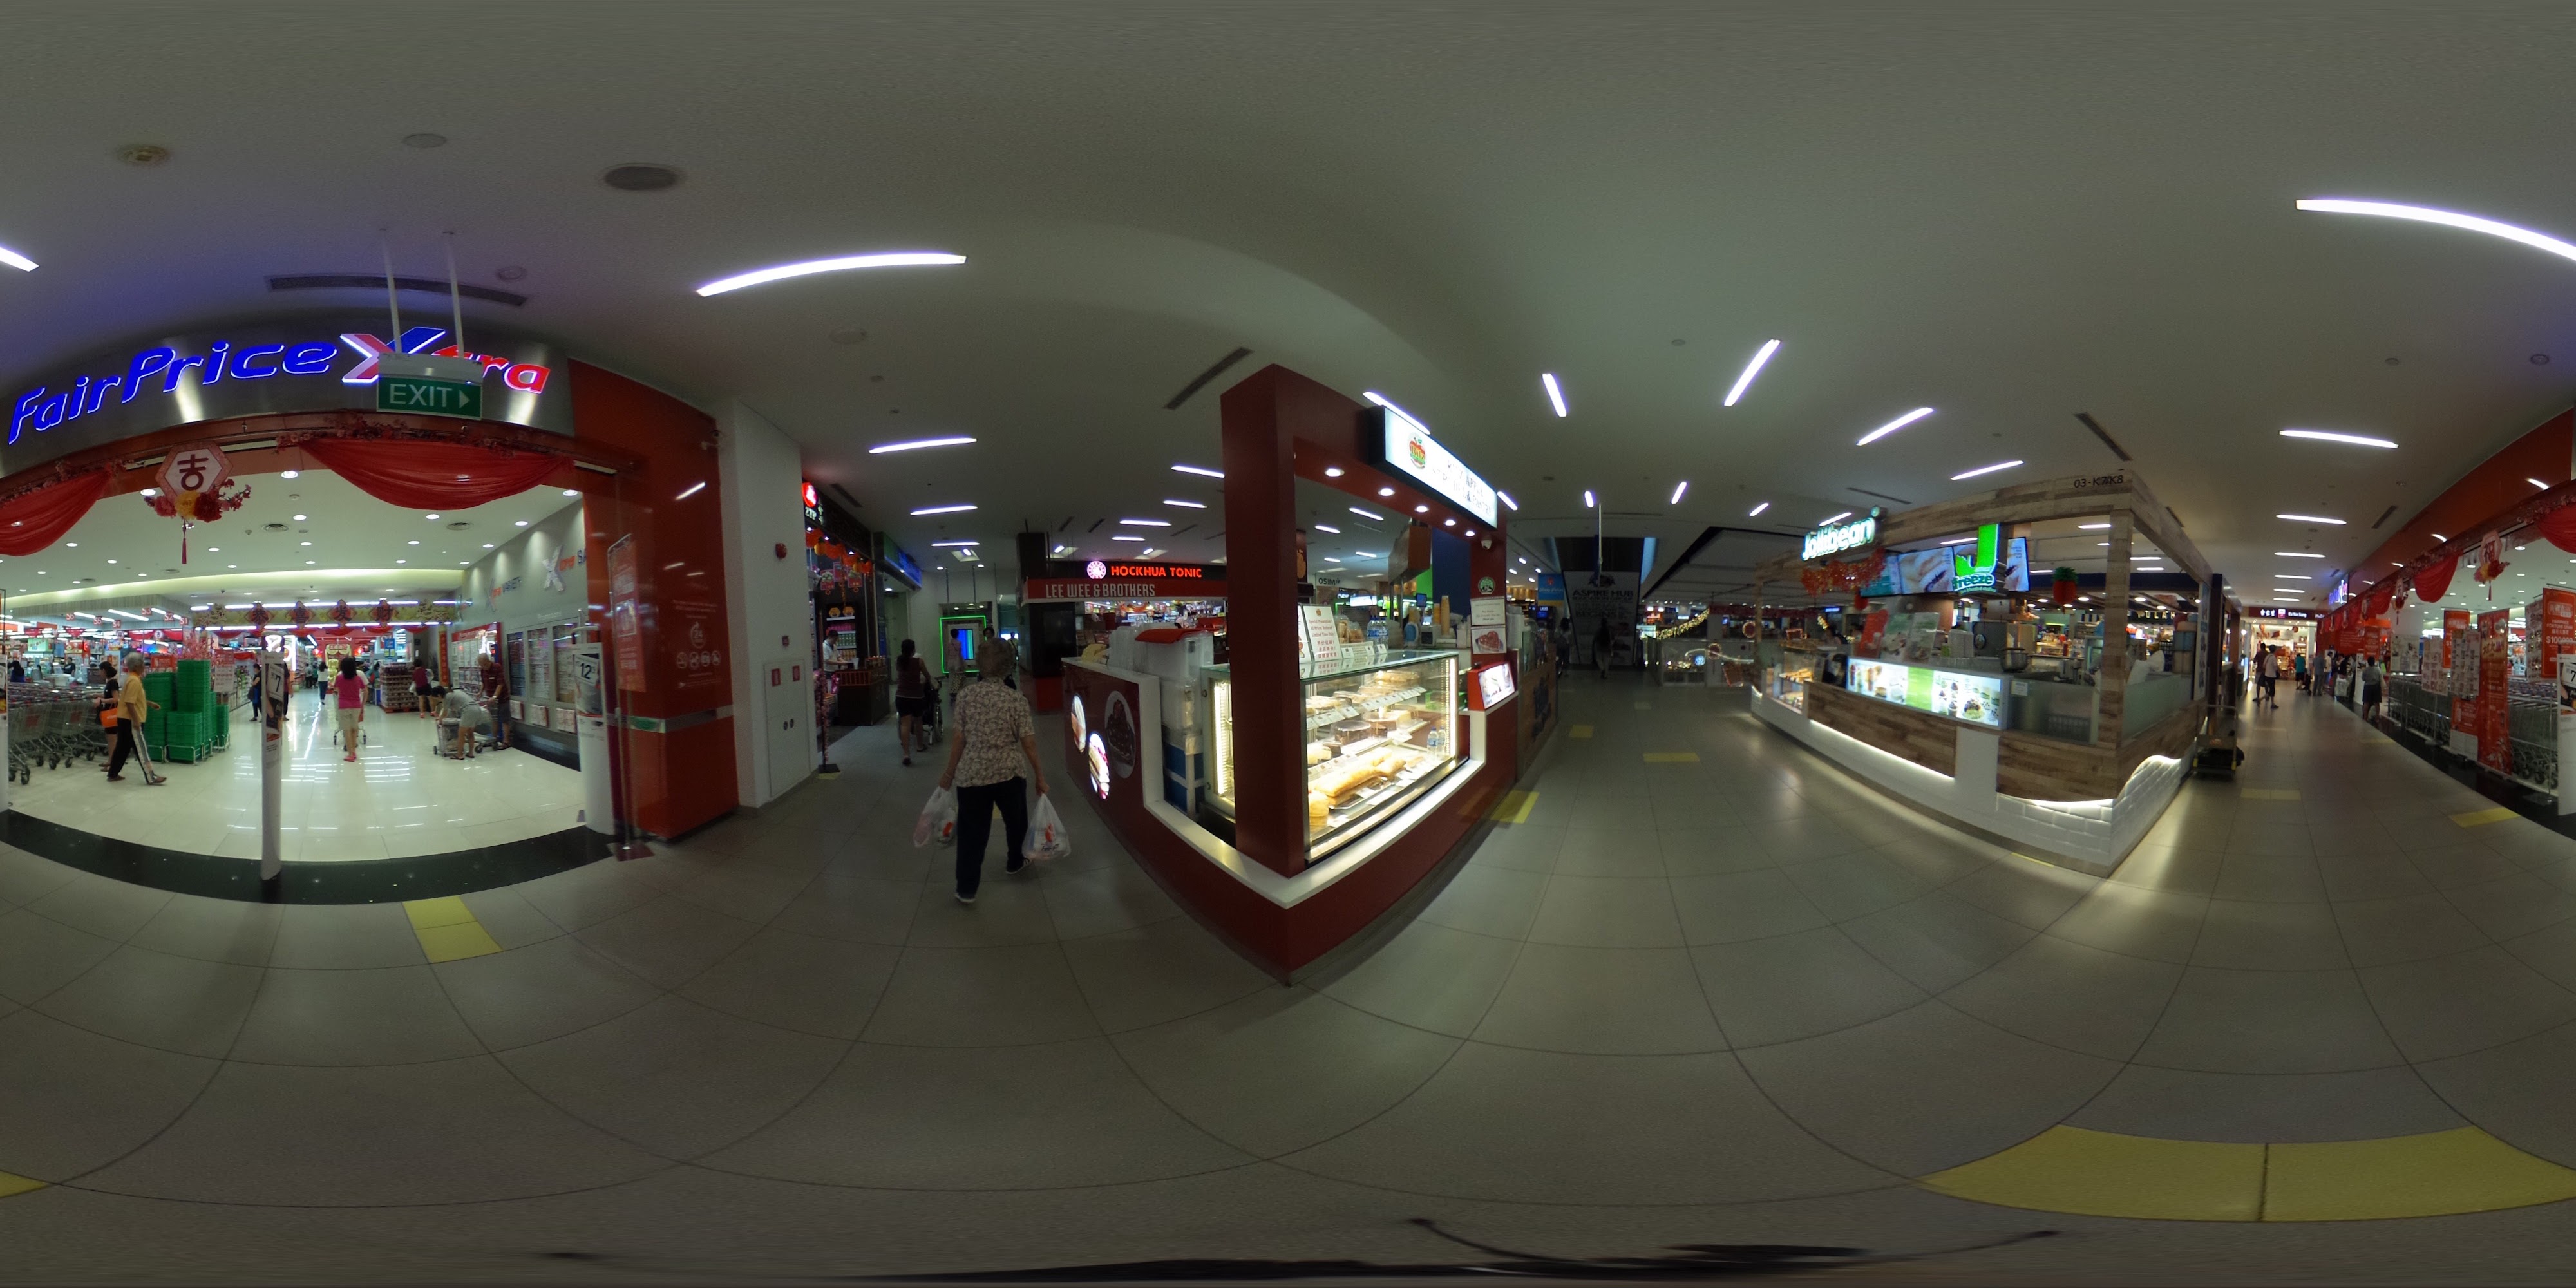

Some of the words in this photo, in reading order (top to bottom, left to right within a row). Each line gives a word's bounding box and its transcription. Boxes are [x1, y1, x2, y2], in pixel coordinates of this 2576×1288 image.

[8, 340, 337, 446] FairPrice
[390, 384, 453, 408] EXIT
[1801, 517, 1875, 561] Jollibean
[1110, 565, 1166, 577] HOCKHUA
[1170, 567, 1202, 578] TONIC
[1046, 584, 1064, 598] LEE
[1067, 584, 1090, 598] WEE
[1093, 583, 1100, 598] &
[1102, 583, 1156, 598] BROTHERS
